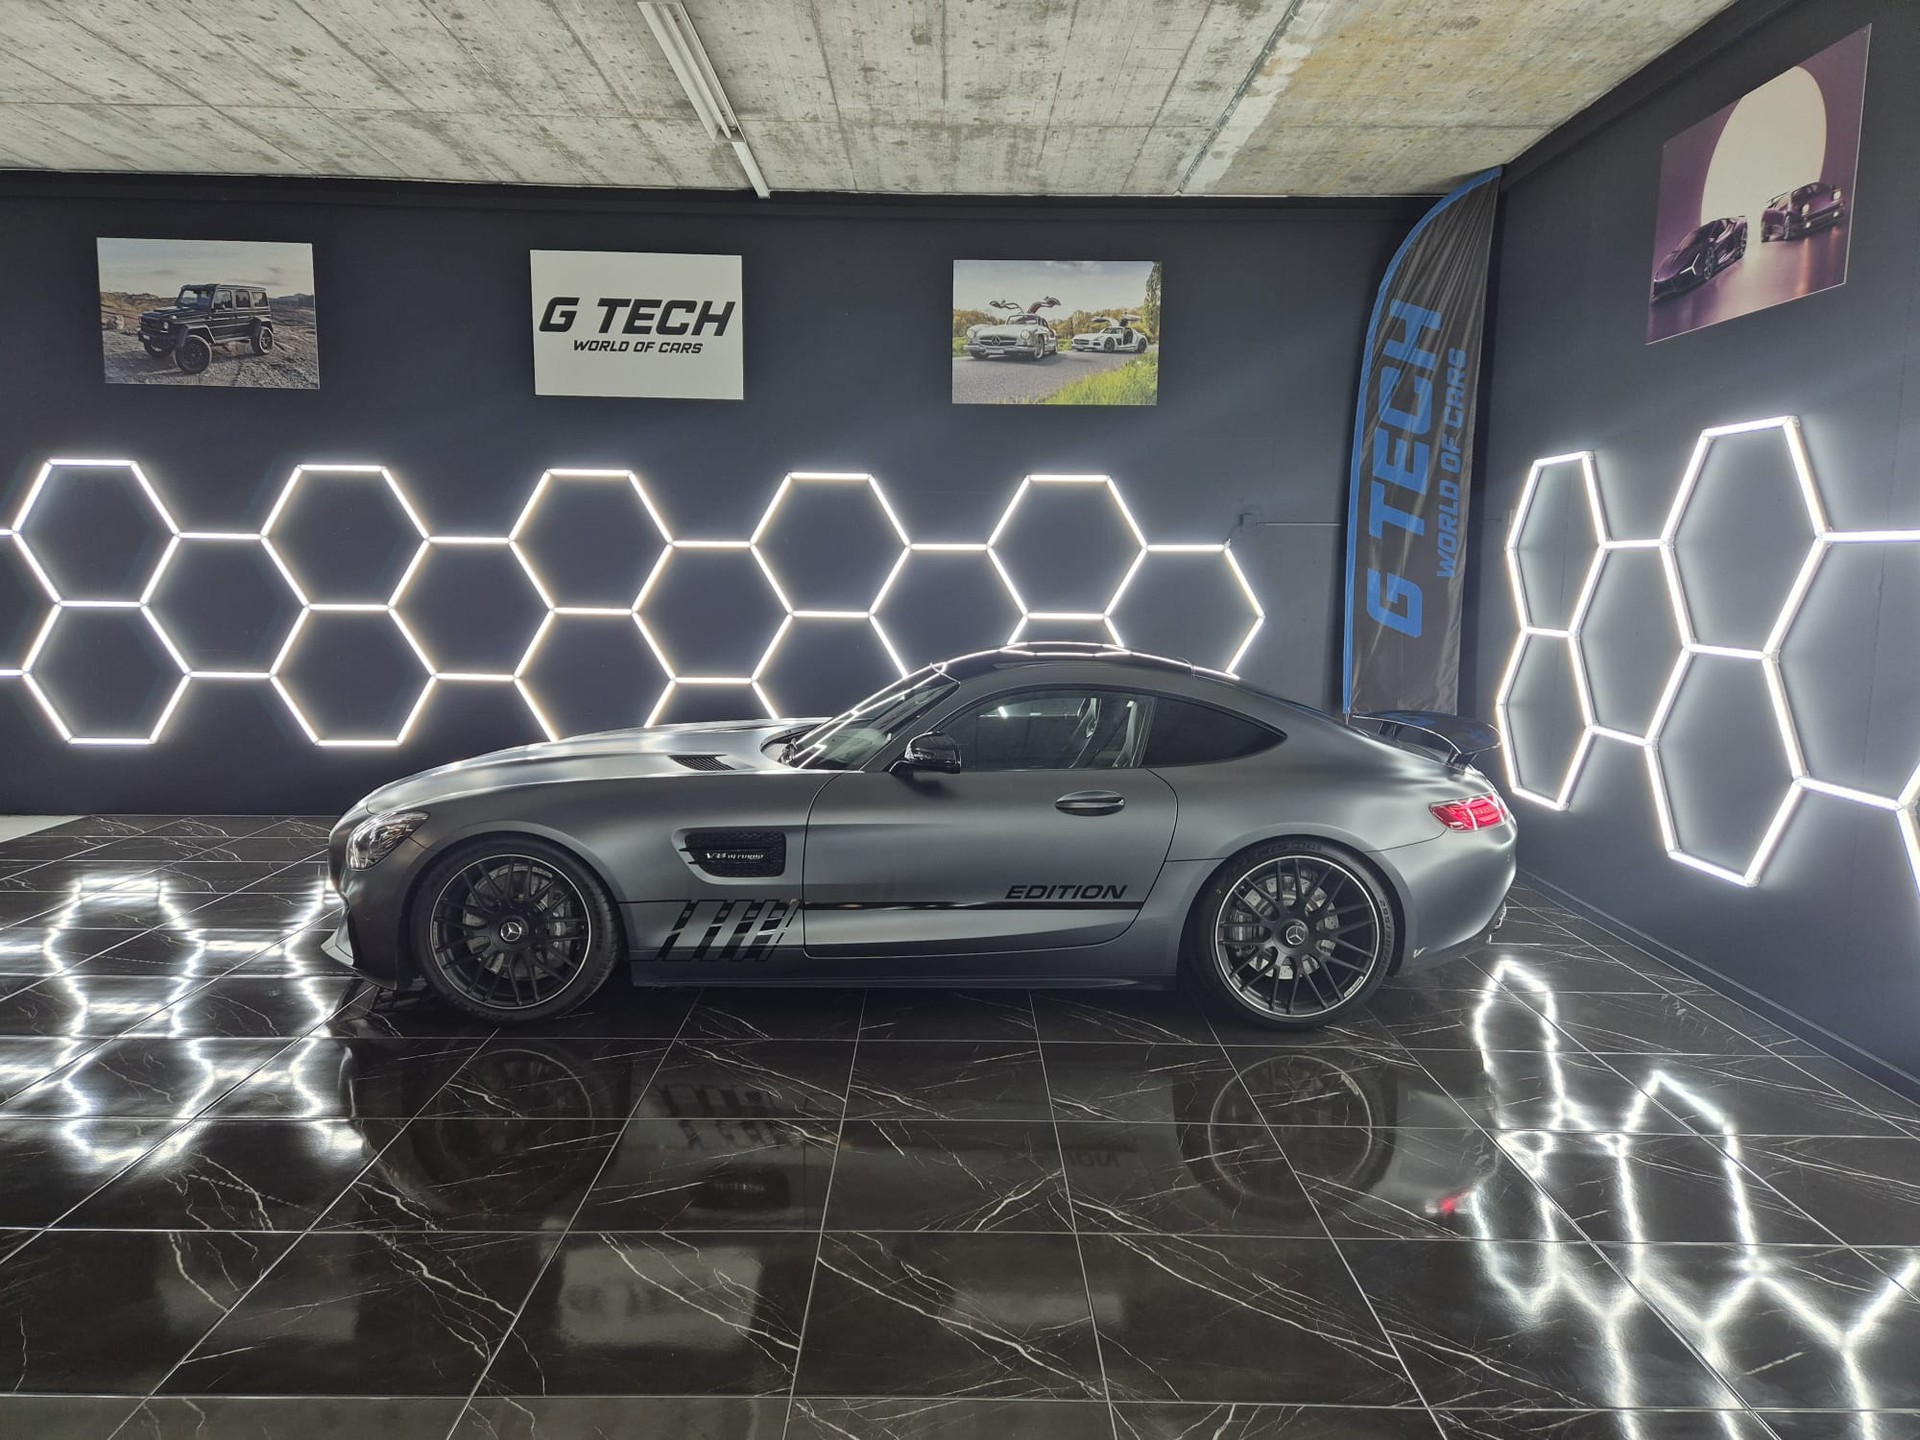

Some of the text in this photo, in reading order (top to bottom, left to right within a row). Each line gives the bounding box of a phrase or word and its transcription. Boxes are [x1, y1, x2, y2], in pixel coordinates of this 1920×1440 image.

[539, 297, 736, 336] G TECH
[573, 340, 703, 354] WORLD OF CARS
[1367, 299, 1441, 638] G TECH
[1437, 347, 1467, 577] WORLD OF CARS
[1005, 885, 1128, 899] EDITION
